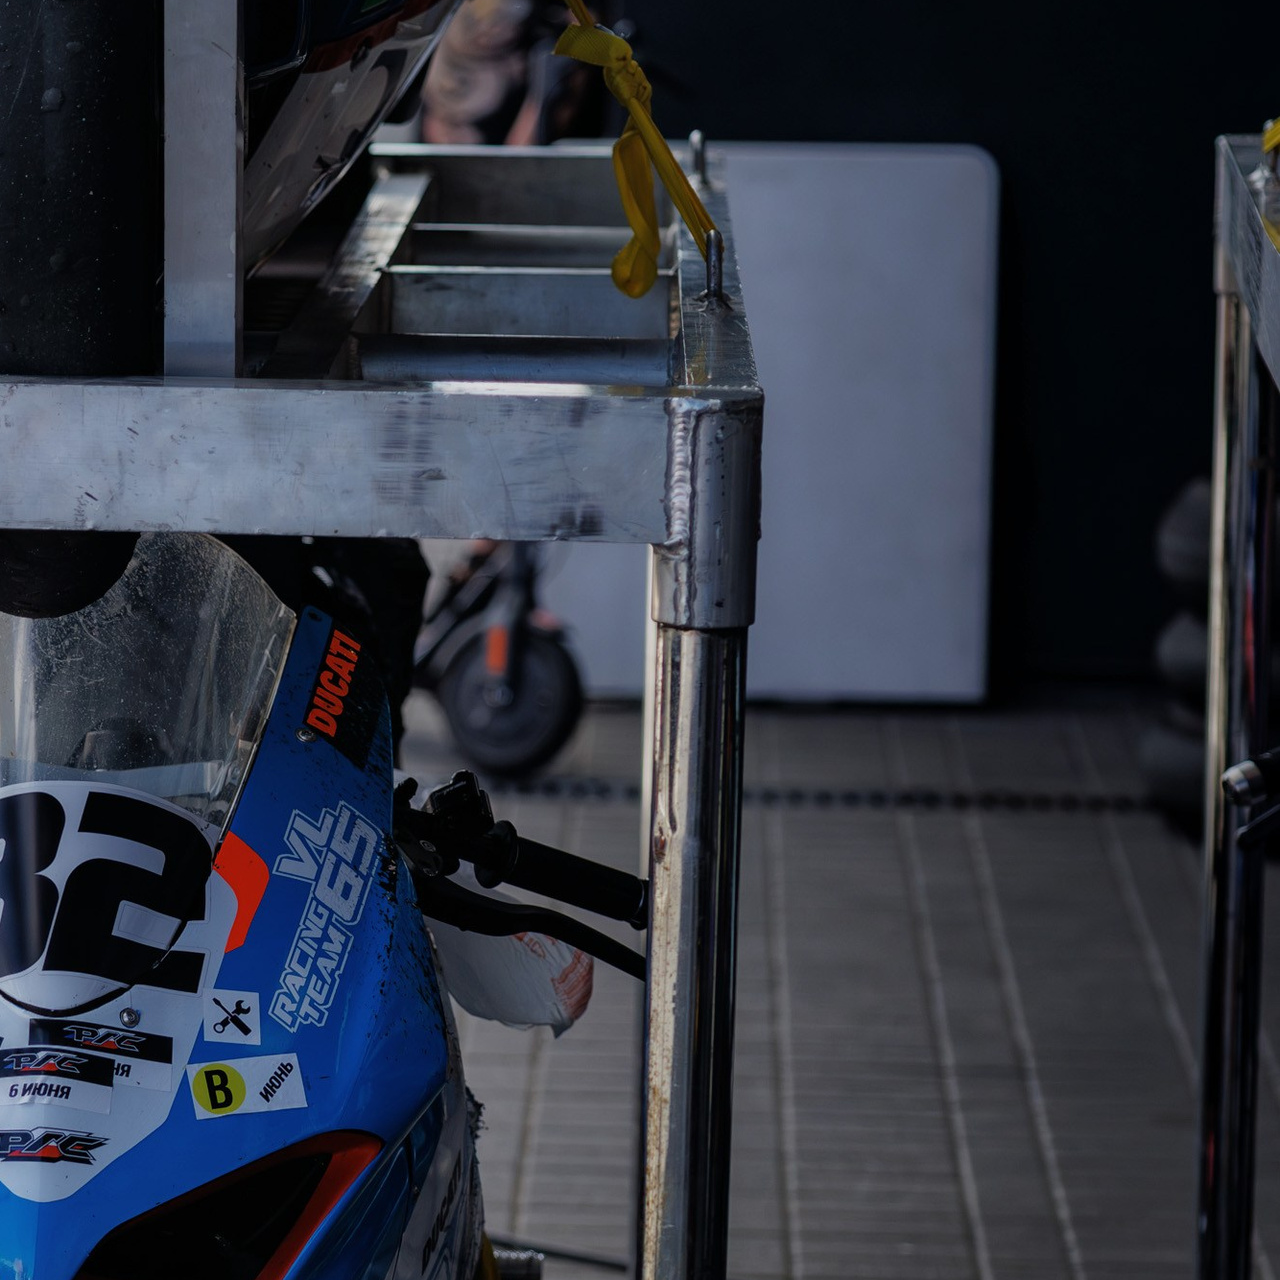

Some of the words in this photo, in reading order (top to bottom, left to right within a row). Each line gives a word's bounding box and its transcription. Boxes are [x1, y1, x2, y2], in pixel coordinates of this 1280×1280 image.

[307, 629, 361, 737] DUCATI
[314, 806, 378, 921] 65
[273, 905, 330, 1026] RACING
[298, 924, 346, 1022] TEAM
[9, 1084, 18, 1097] 6
[21, 1083, 71, 1099] ИЮНЯ
[204, 1069, 234, 1110] B
[259, 1062, 294, 1103] ИЮНЬ
